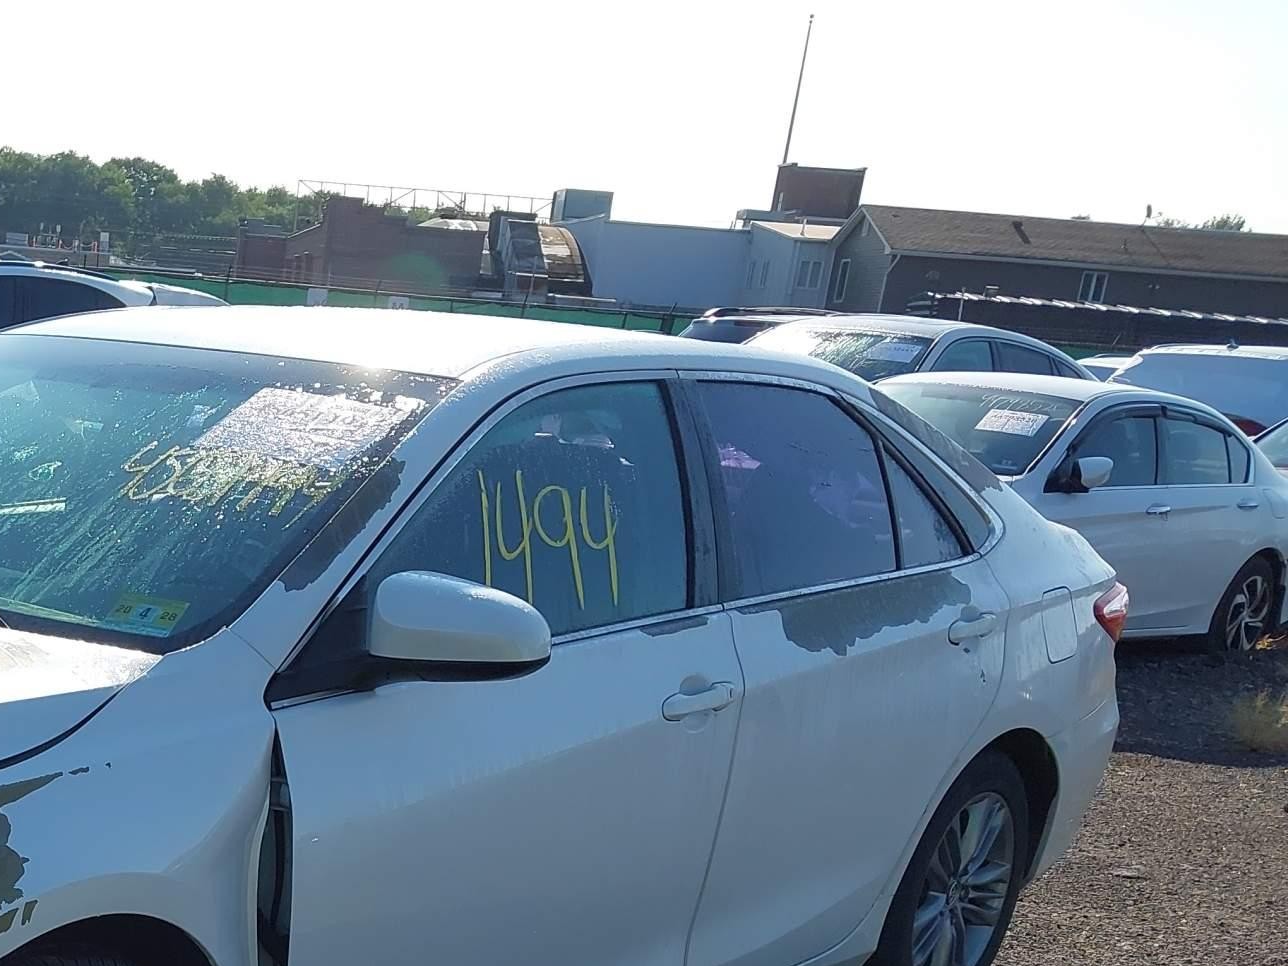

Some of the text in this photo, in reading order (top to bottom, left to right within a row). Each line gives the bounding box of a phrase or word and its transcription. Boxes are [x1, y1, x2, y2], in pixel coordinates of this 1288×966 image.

[477, 468, 618, 611] 1494
[116, 605, 178, 622] 20 4 28
